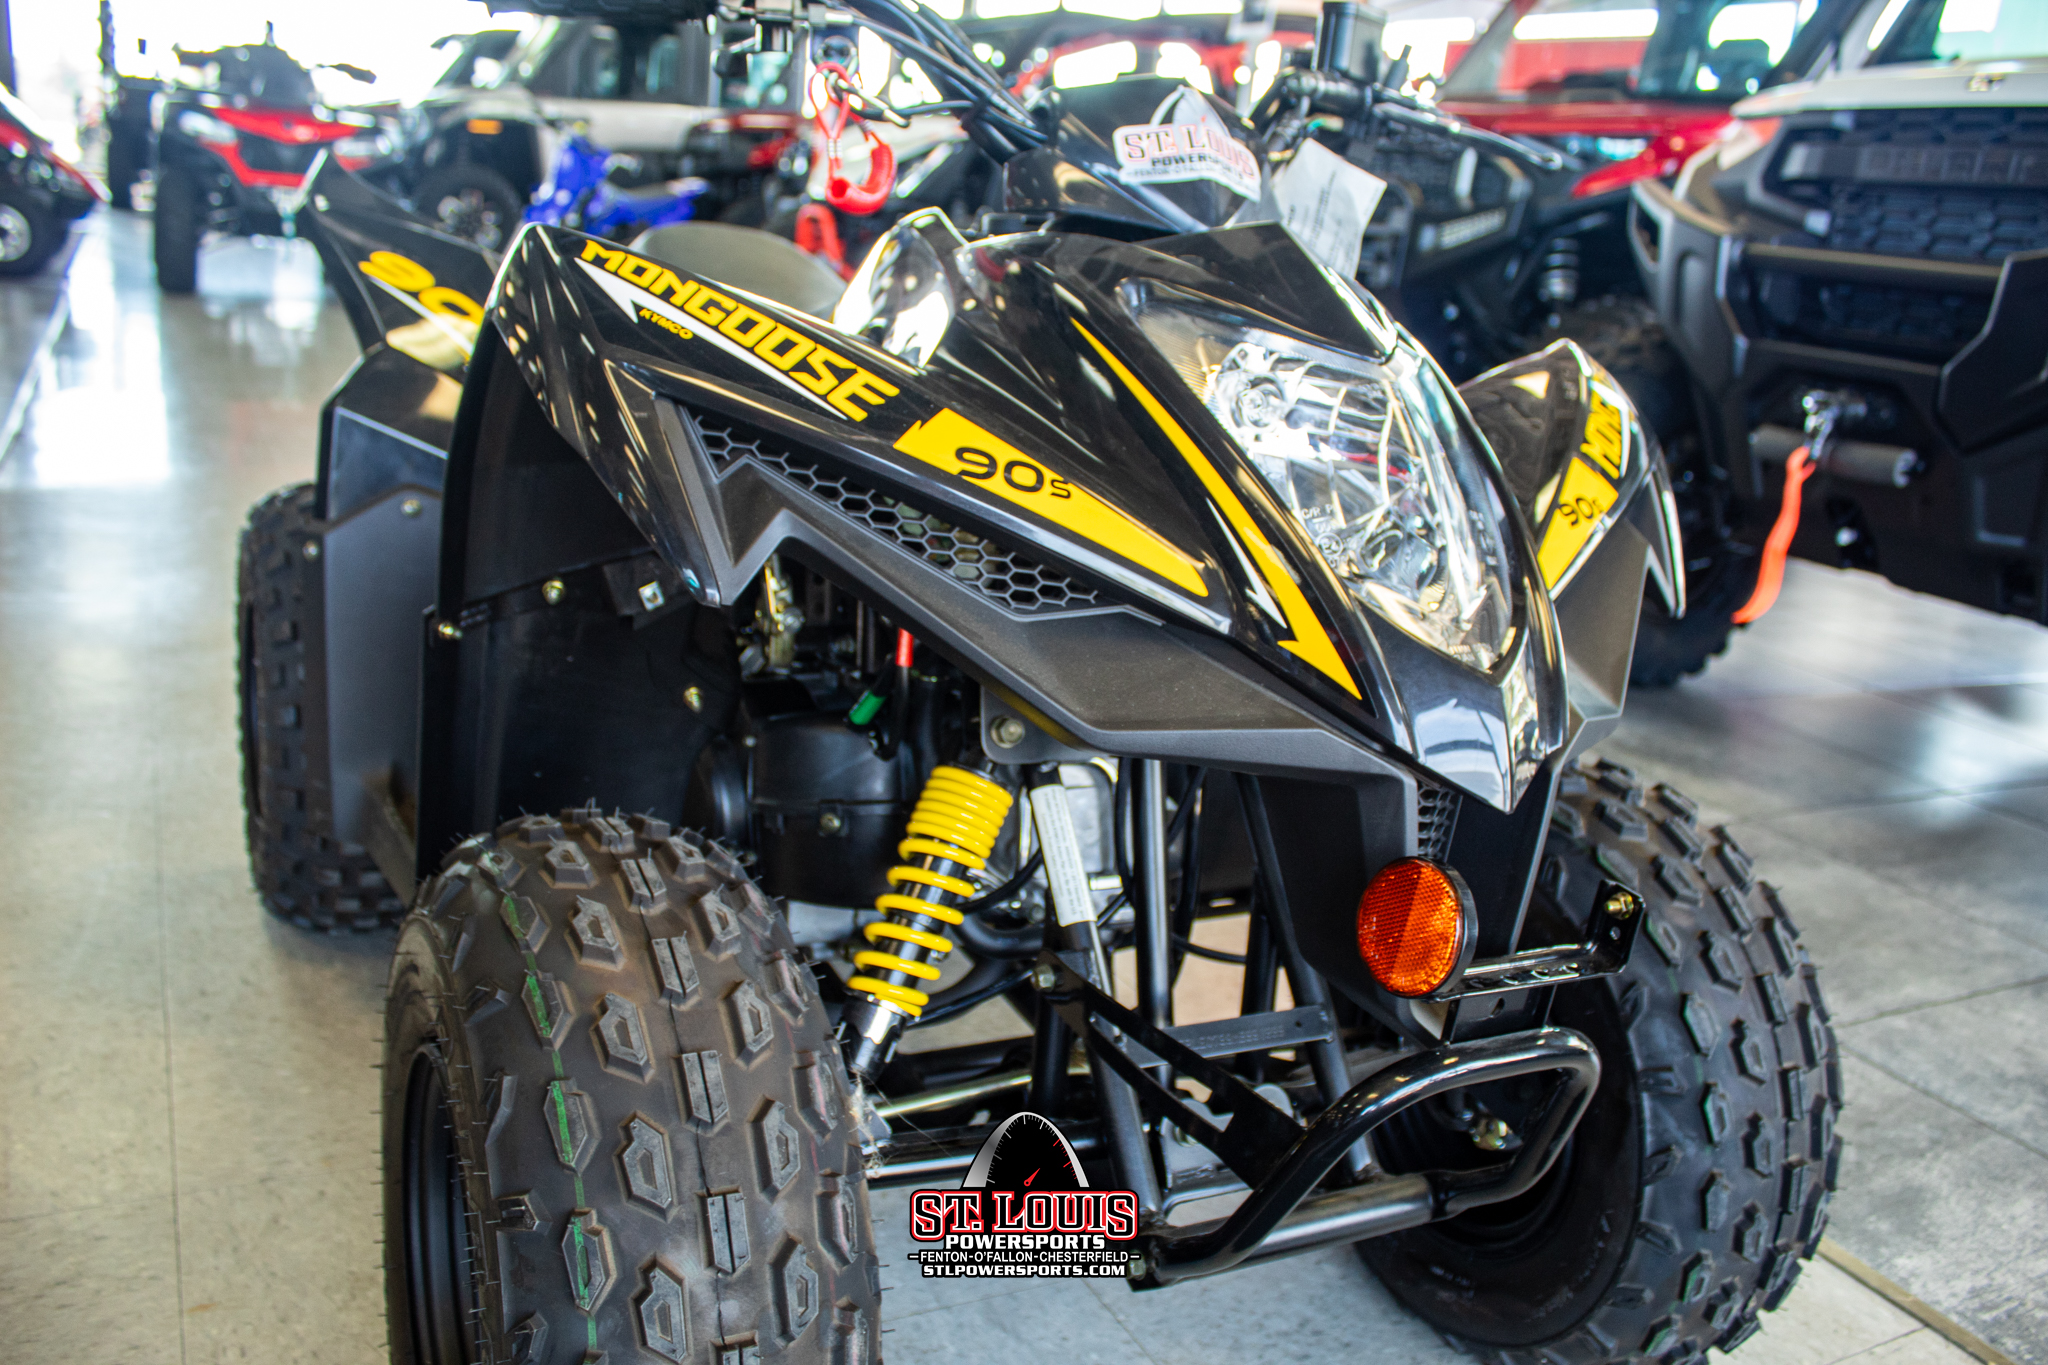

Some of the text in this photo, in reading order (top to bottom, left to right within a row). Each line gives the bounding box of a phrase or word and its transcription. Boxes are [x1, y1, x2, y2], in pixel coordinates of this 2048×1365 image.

[1122, 125, 1179, 162] ST.
[581, 240, 900, 422] MONGOOSE
[638, 307, 694, 340] KYMCO
